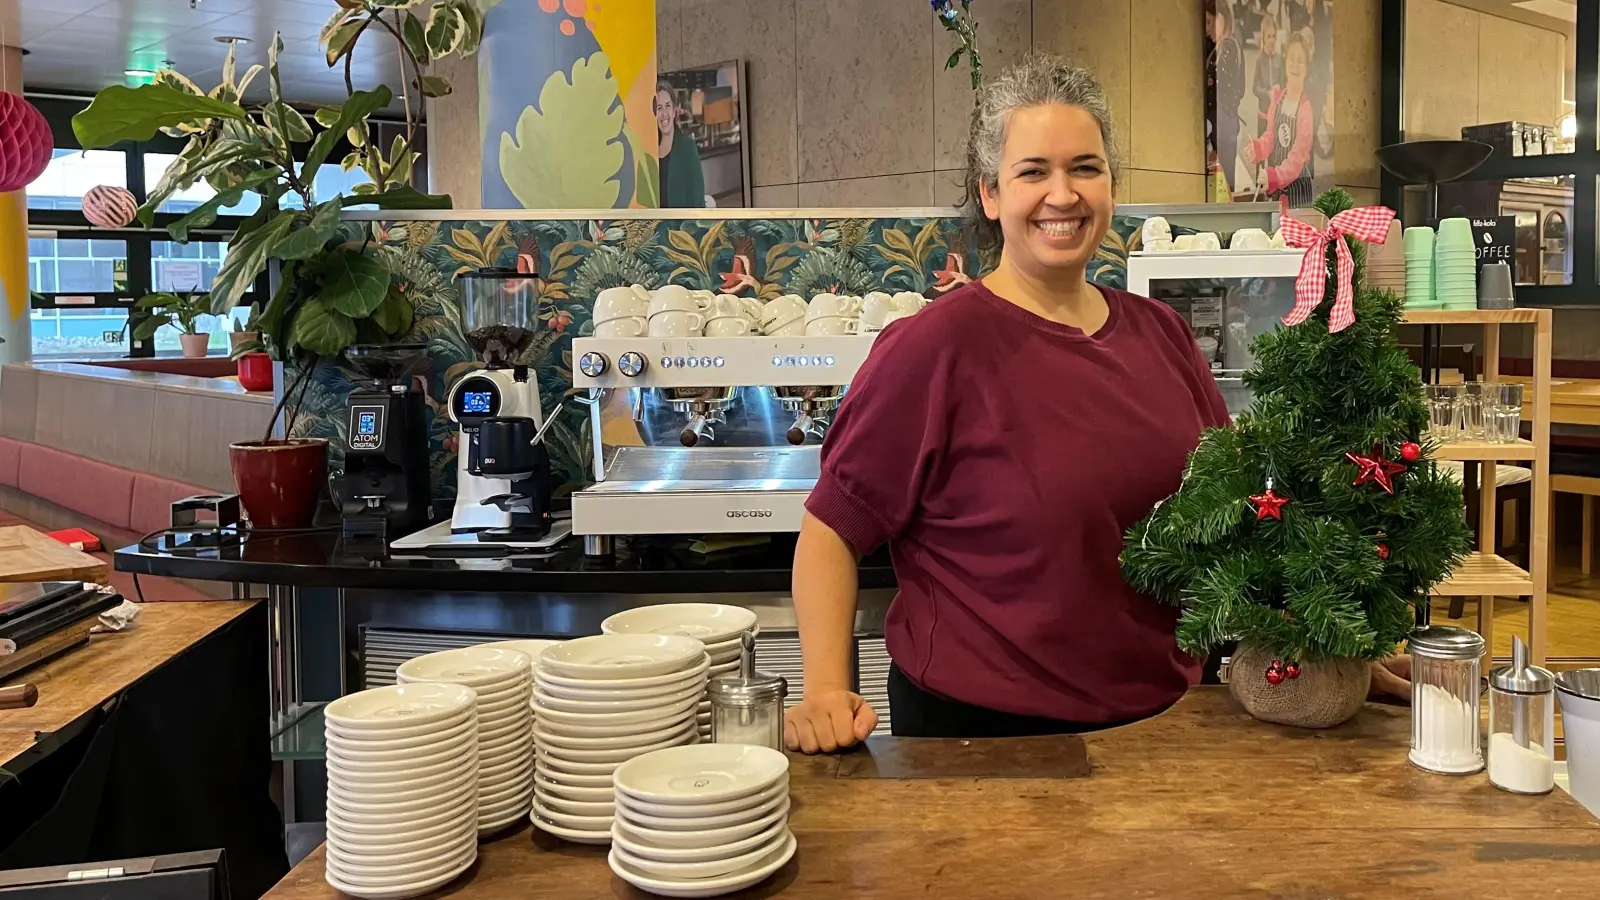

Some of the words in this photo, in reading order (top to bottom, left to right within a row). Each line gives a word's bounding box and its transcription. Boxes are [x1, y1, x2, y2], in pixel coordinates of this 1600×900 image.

[1475, 245, 1511, 259] OFFEE
[353, 434, 379, 442] ATOM
[726, 510, 773, 518] ascaso
